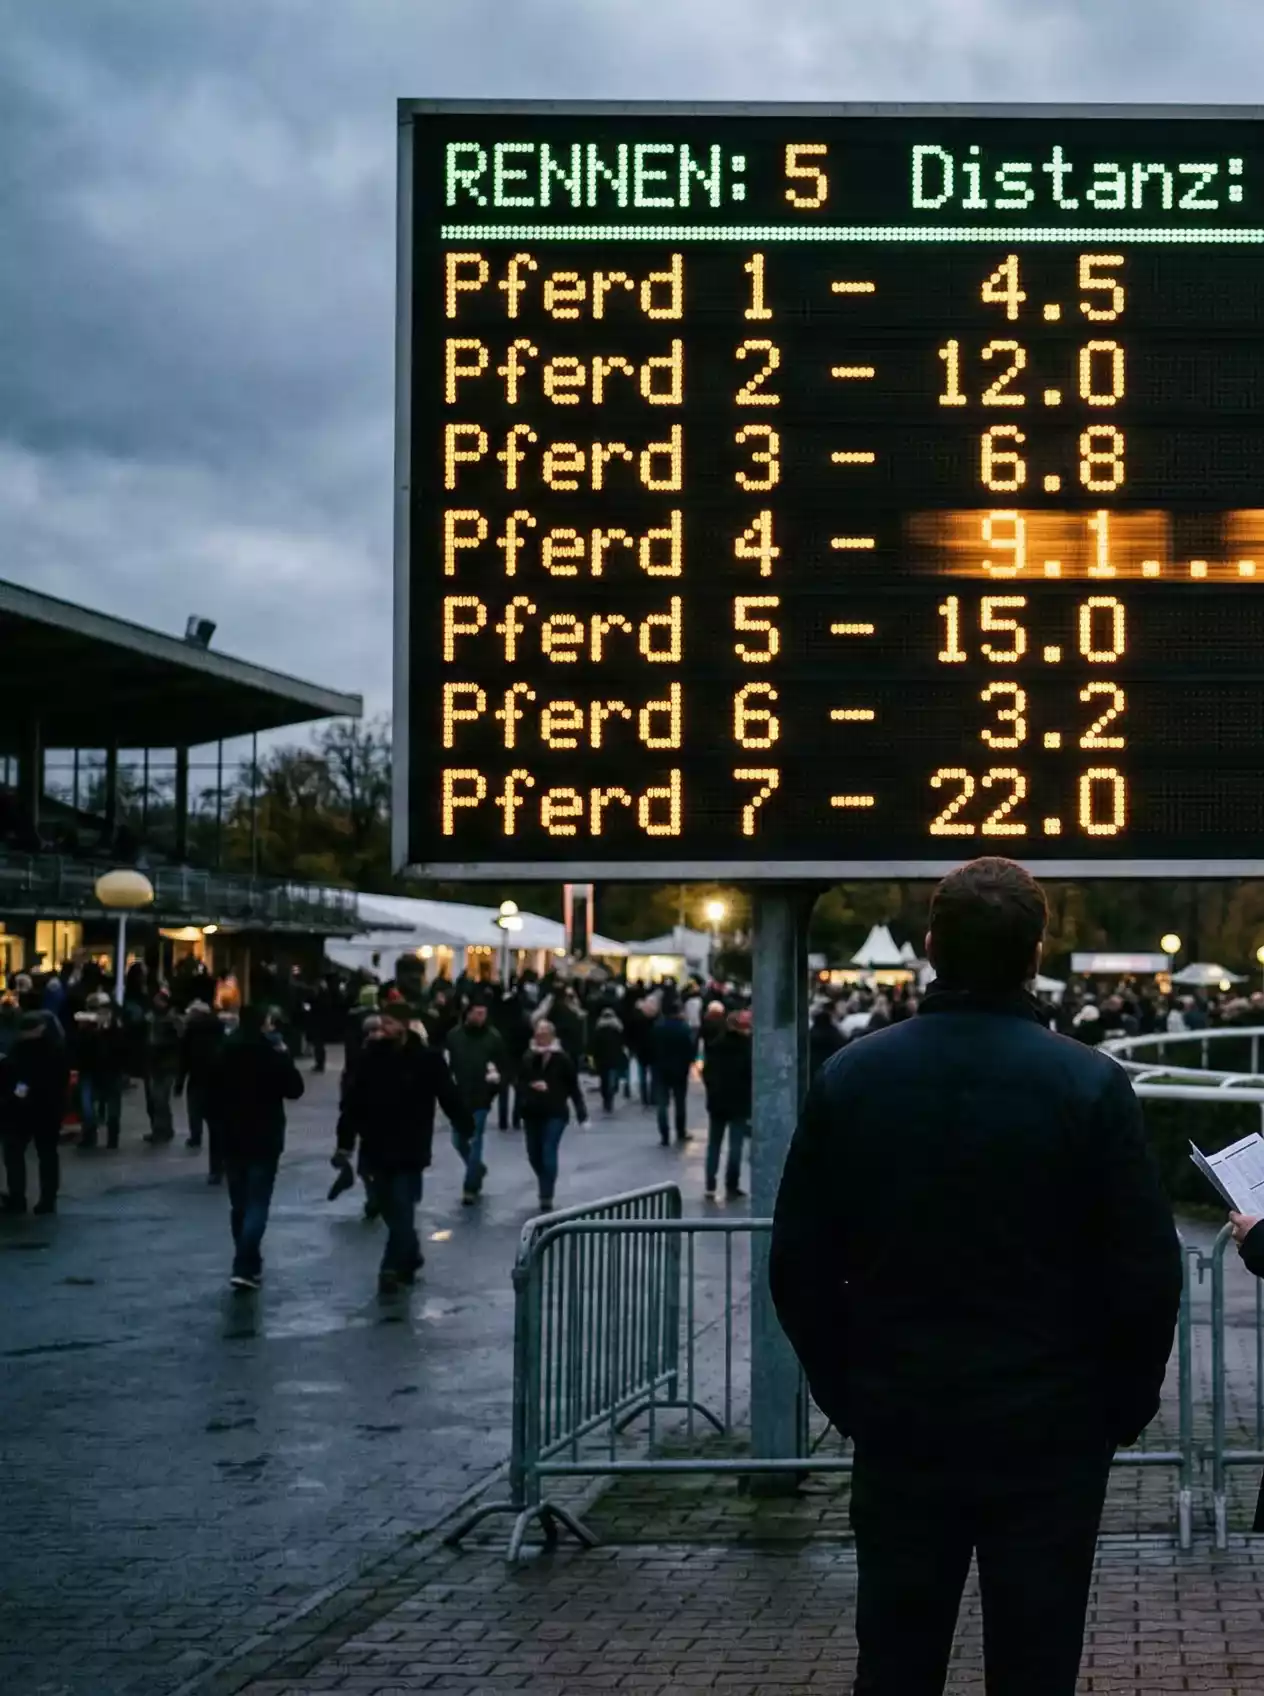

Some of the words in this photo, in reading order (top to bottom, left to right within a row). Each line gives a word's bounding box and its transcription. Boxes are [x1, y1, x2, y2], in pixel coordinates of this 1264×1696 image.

[446, 142, 746, 208] RENNEN:
[785, 143, 828, 208] 5
[911, 144, 1243, 210] Distanz:
[444, 253, 683, 320] Pferd
[744, 253, 772, 320] 1
[831, 280, 875, 292] -
[981, 254, 1125, 321] 4.5
[444, 339, 683, 405] Pferd
[735, 339, 780, 405] 2
[831, 366, 875, 378] -
[938, 340, 1125, 406] 12.0
[444, 424, 683, 491] Pferd
[735, 424, 780, 491] 3
[831, 451, 875, 463] -
[980, 425, 1125, 492] 6.8
[444, 510, 683, 577] Pferd
[734, 510, 780, 577] 4
[831, 537, 875, 549] -
[444, 596, 683, 663] Pferd
[734, 596, 780, 663] 5
[831, 623, 875, 635] -
[938, 597, 1125, 664] 15.0
[444, 682, 683, 749] Pferd
[733, 682, 780, 749] 6
[831, 709, 875, 721] -
[980, 683, 1125, 750] 3.2
[444, 768, 683, 836] Pferd
[733, 768, 780, 836] 7
[831, 795, 875, 807] -
[929, 769, 1125, 837] 22.0
